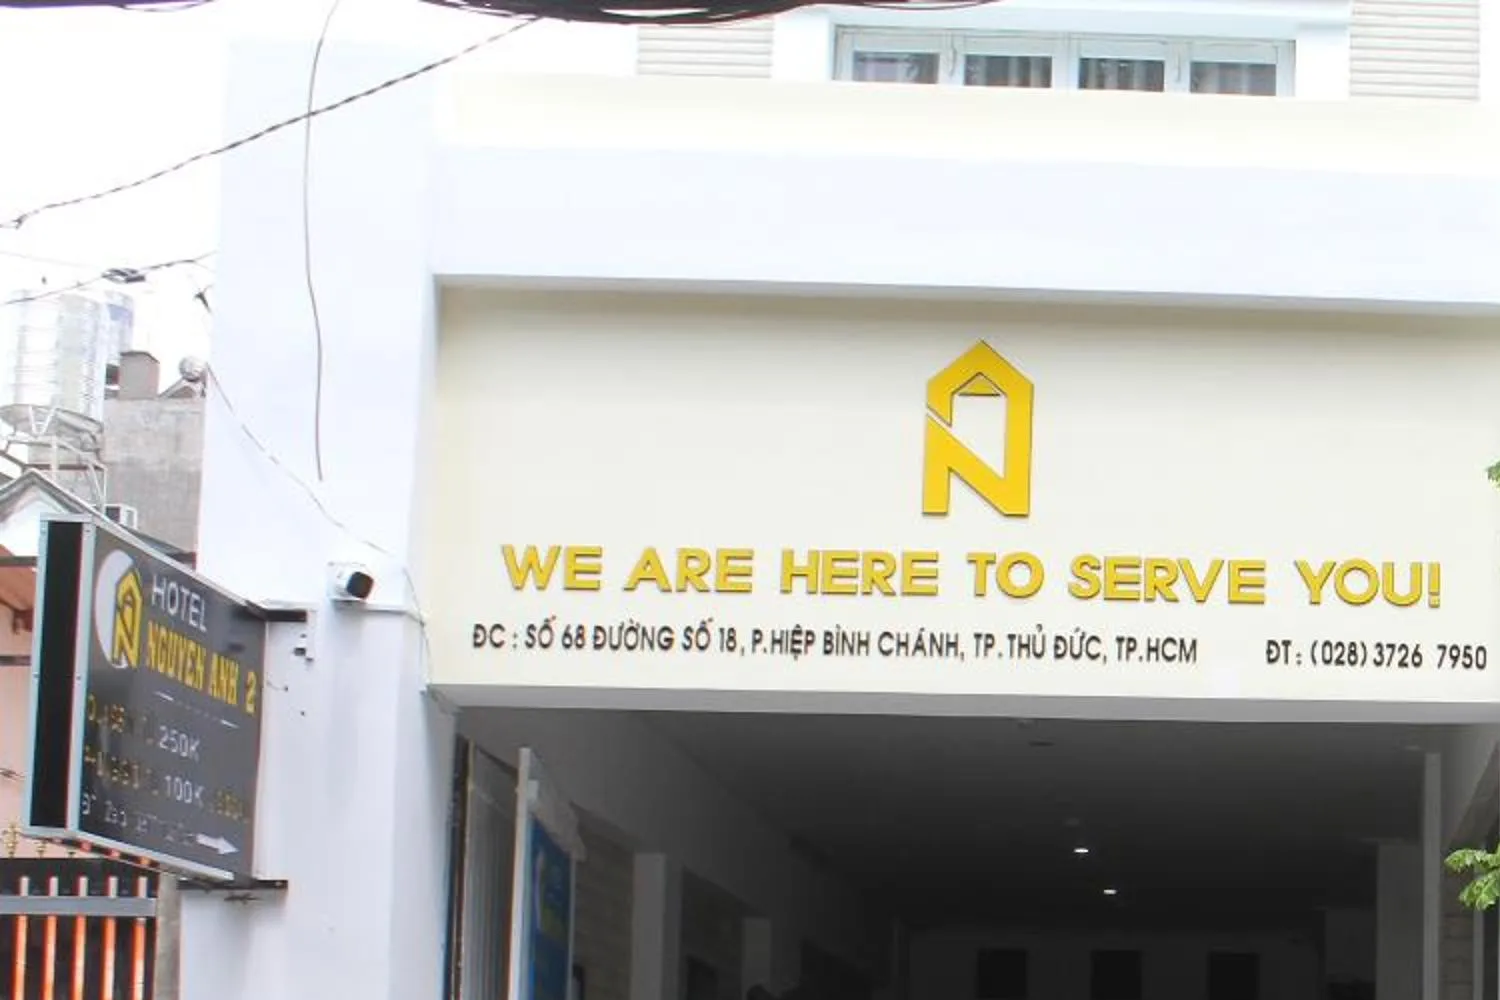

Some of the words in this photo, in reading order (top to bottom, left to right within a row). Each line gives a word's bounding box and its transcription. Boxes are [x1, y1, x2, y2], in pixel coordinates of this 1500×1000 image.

[501, 543, 603, 591] WE
[622, 546, 754, 594] ARE
[779, 548, 940, 597] HERE
[966, 551, 1046, 599] TO
[1066, 553, 1267, 605] SERVE
[1293, 557, 1442, 609] YOU!
[151, 573, 208, 633] HOTEL
[524, 614, 557, 650] SỐ
[561, 624, 586, 650] 68
[592, 617, 675, 651] ĐƯỜNG
[680, 617, 714, 652] SỐ
[822, 623, 871, 657] BÌNH
[1436, 643, 1488, 670] 7950
[145, 619, 207, 692] NGUYEN
[208, 652, 241, 706] ANH
[244, 670, 258, 715] 2
[158, 725, 201, 763] 250K
